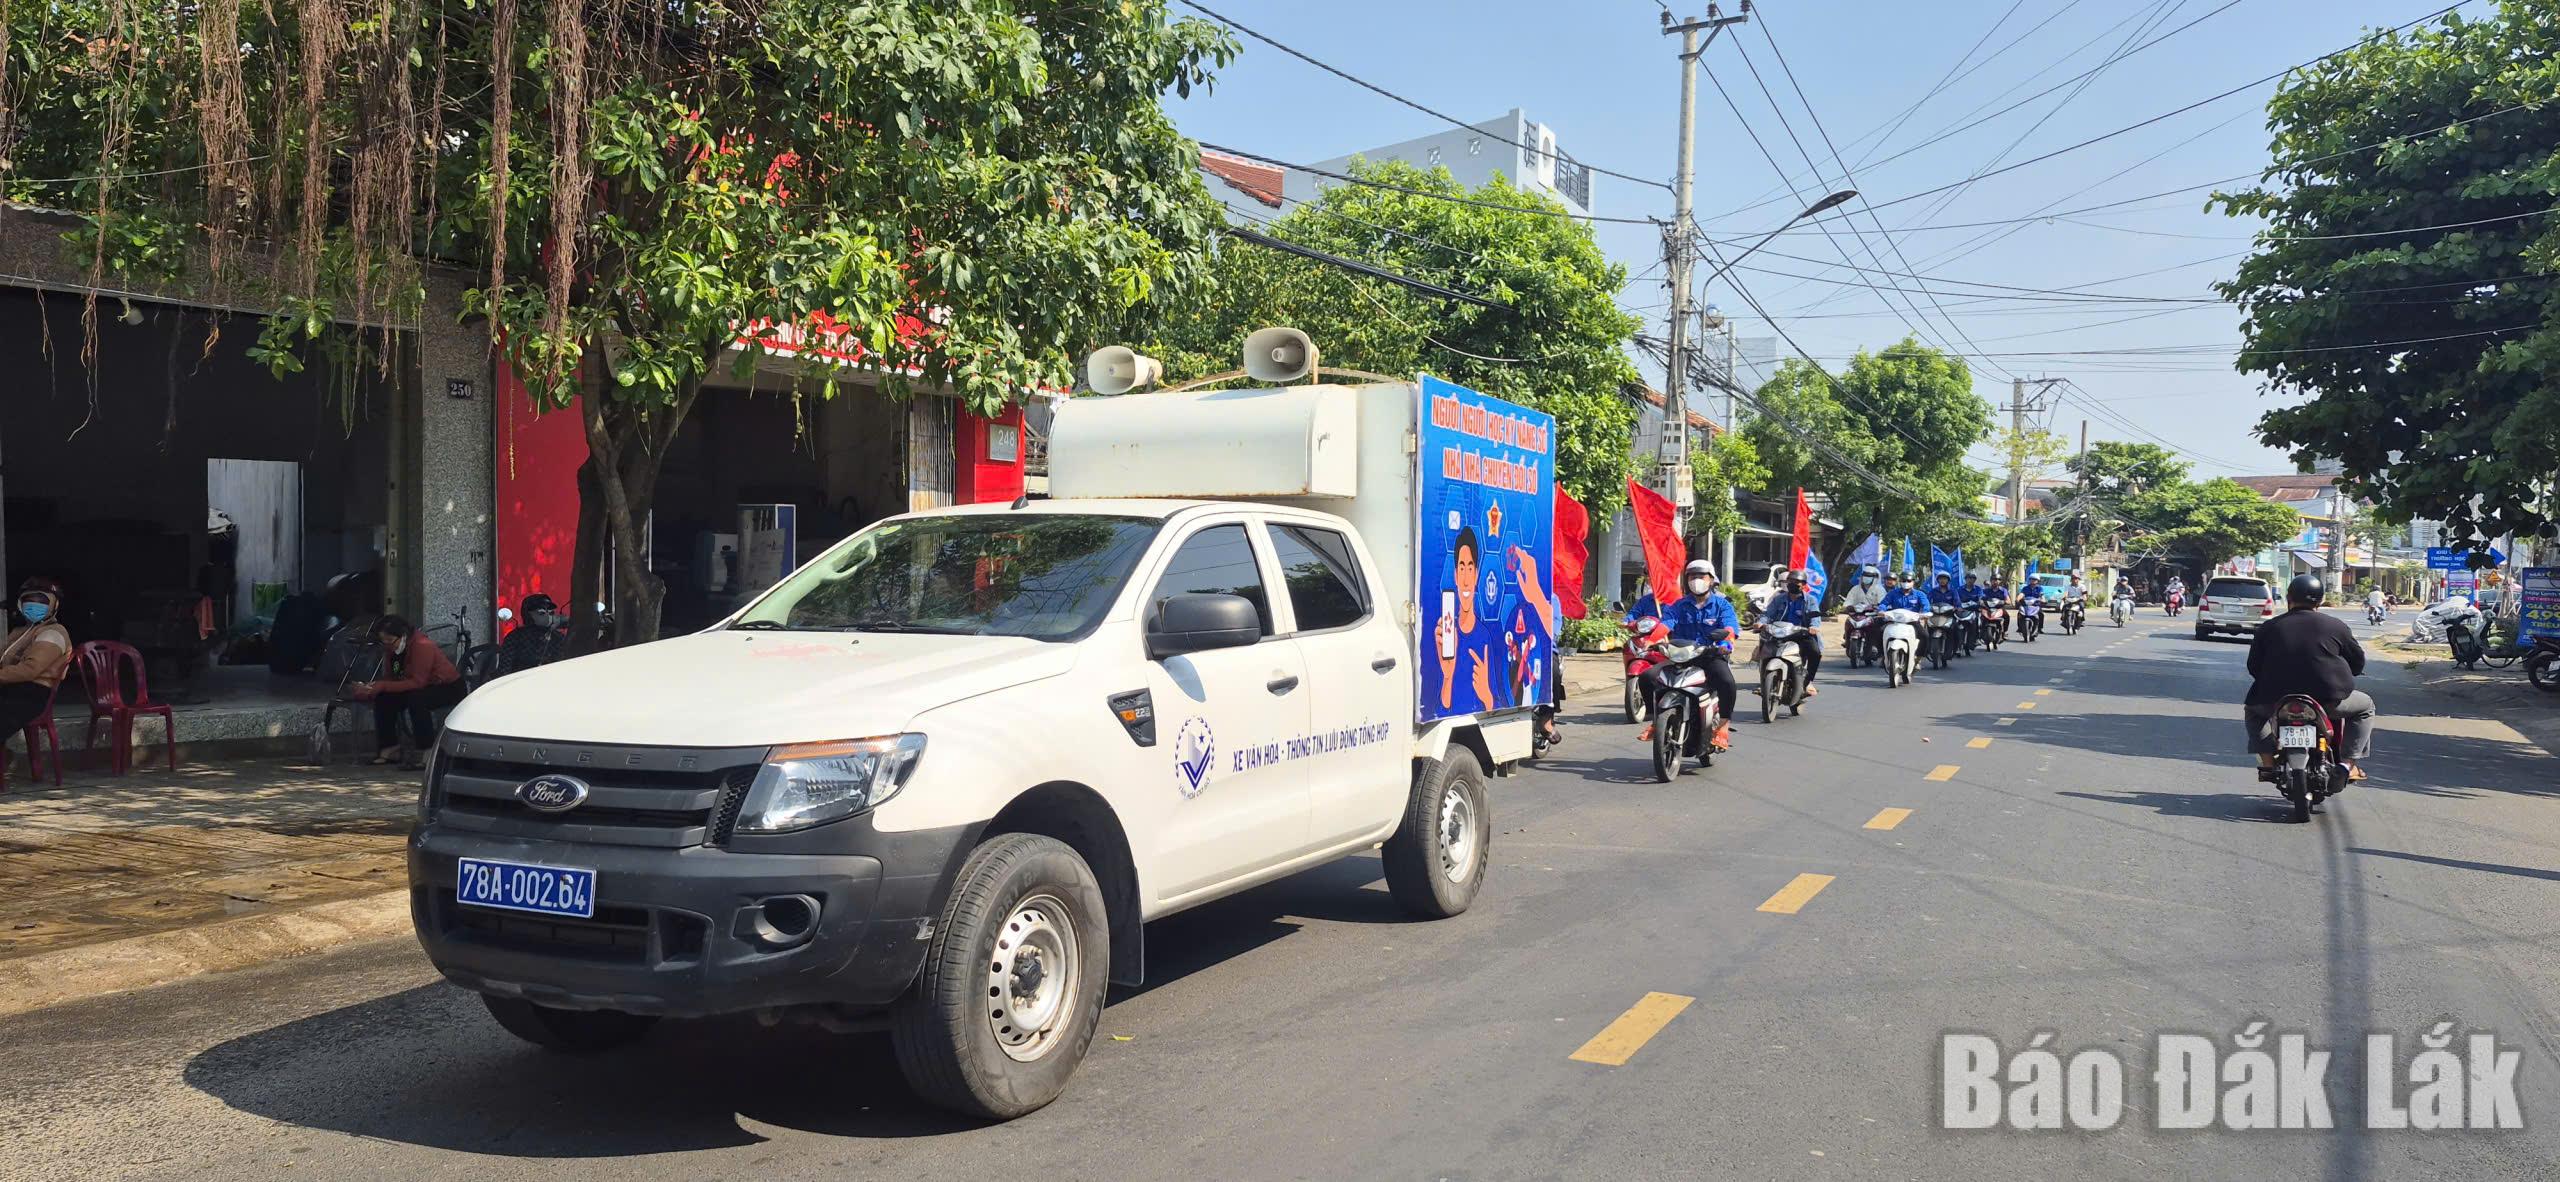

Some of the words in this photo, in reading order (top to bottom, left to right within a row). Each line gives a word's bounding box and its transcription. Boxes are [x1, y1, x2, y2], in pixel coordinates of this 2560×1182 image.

[450, 383, 471, 397] 250
[998, 430, 1015, 447] 248
[1487, 411, 1504, 448] HỌC
[1443, 444, 1462, 480] NHÀ
[1463, 448, 1482, 484] NHÀ
[1233, 750, 1243, 773] XE
[1264, 738, 1279, 766] HÓA
[1287, 733, 1311, 760] THÔNG
[1312, 734, 1324, 756] TIN
[1340, 725, 1357, 753] ĐỘNG
[1359, 716, 1375, 746] TỔNG
[529, 780, 565, 803] Ford
[463, 864, 587, 911] 78A-002.64
